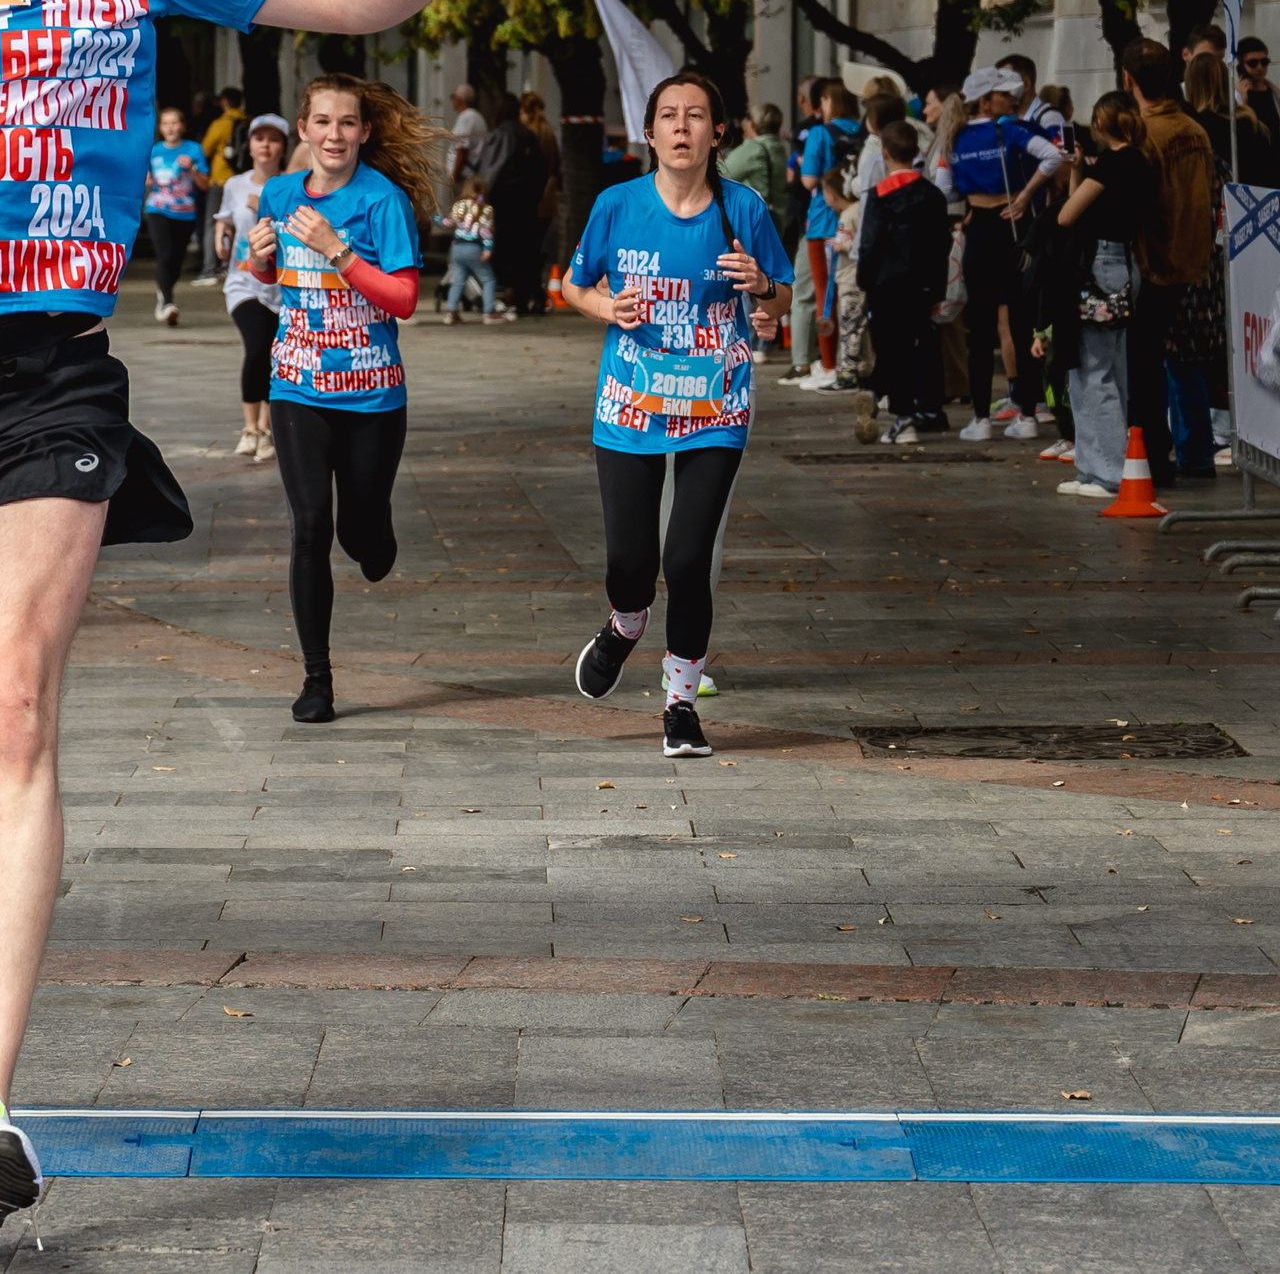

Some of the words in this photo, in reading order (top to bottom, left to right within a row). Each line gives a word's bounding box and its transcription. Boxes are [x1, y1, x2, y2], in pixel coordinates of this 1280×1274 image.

[27, 183, 107, 239] 2024
[617, 248, 660, 276] 2024
[350, 343, 391, 371] 2024
[312, 363, 404, 393] #ЕДИНСТВО
[650, 372, 708, 398] 20186
